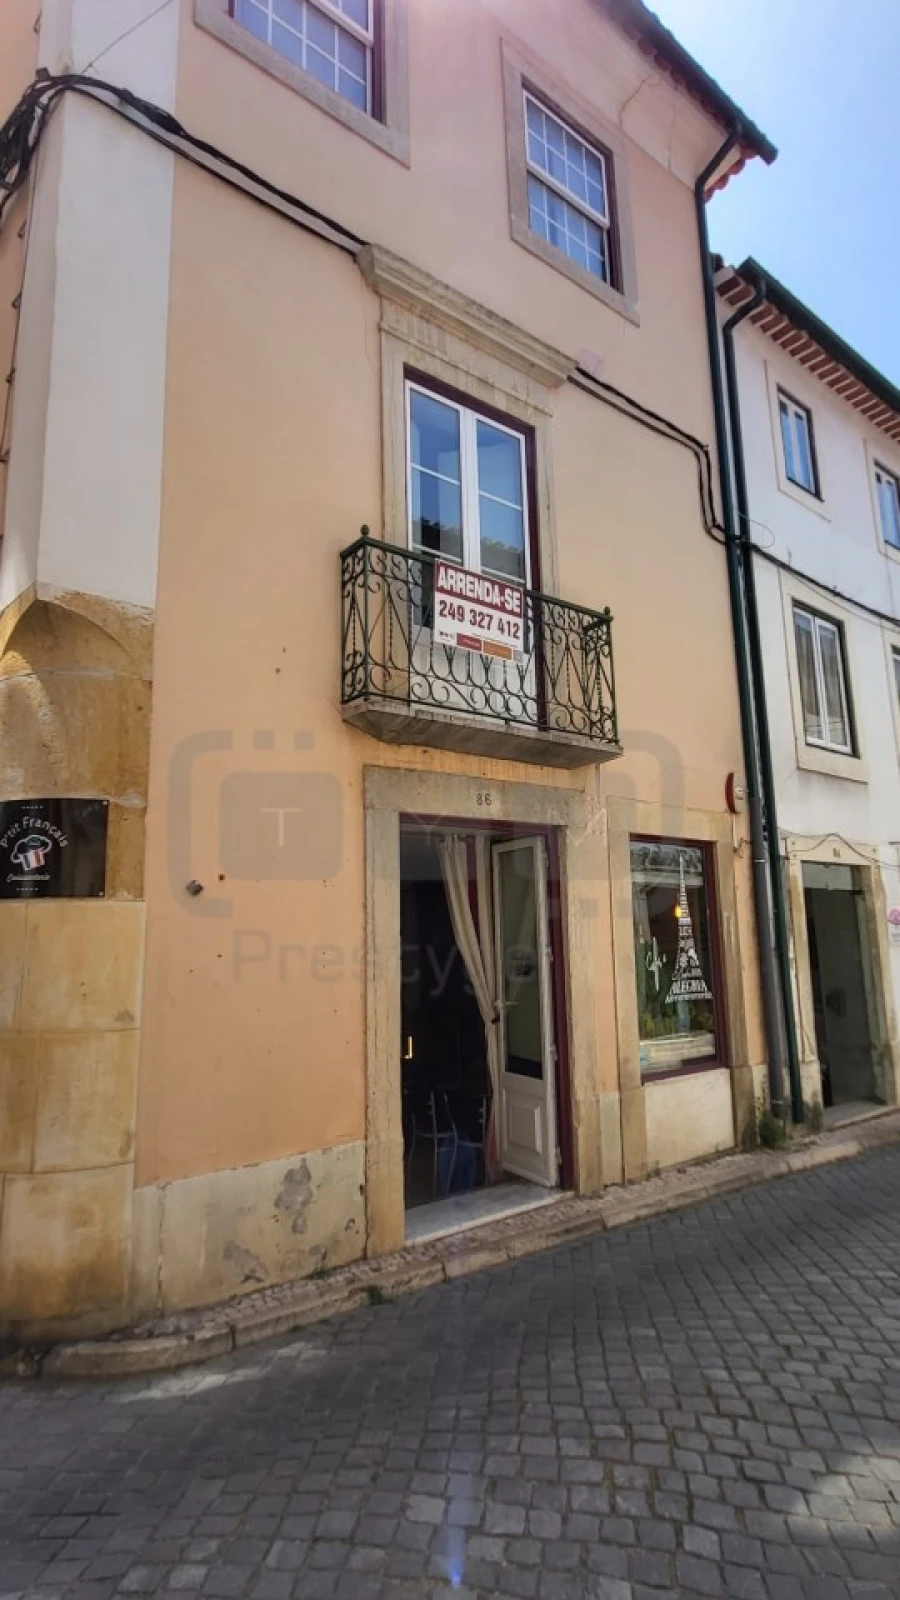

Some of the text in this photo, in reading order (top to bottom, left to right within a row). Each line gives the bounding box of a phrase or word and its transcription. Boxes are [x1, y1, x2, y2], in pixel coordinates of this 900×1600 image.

[437, 565, 521, 613] ARRENDA-SE
[439, 599, 520, 639] 249 327 412
[476, 792, 492, 806] 86
